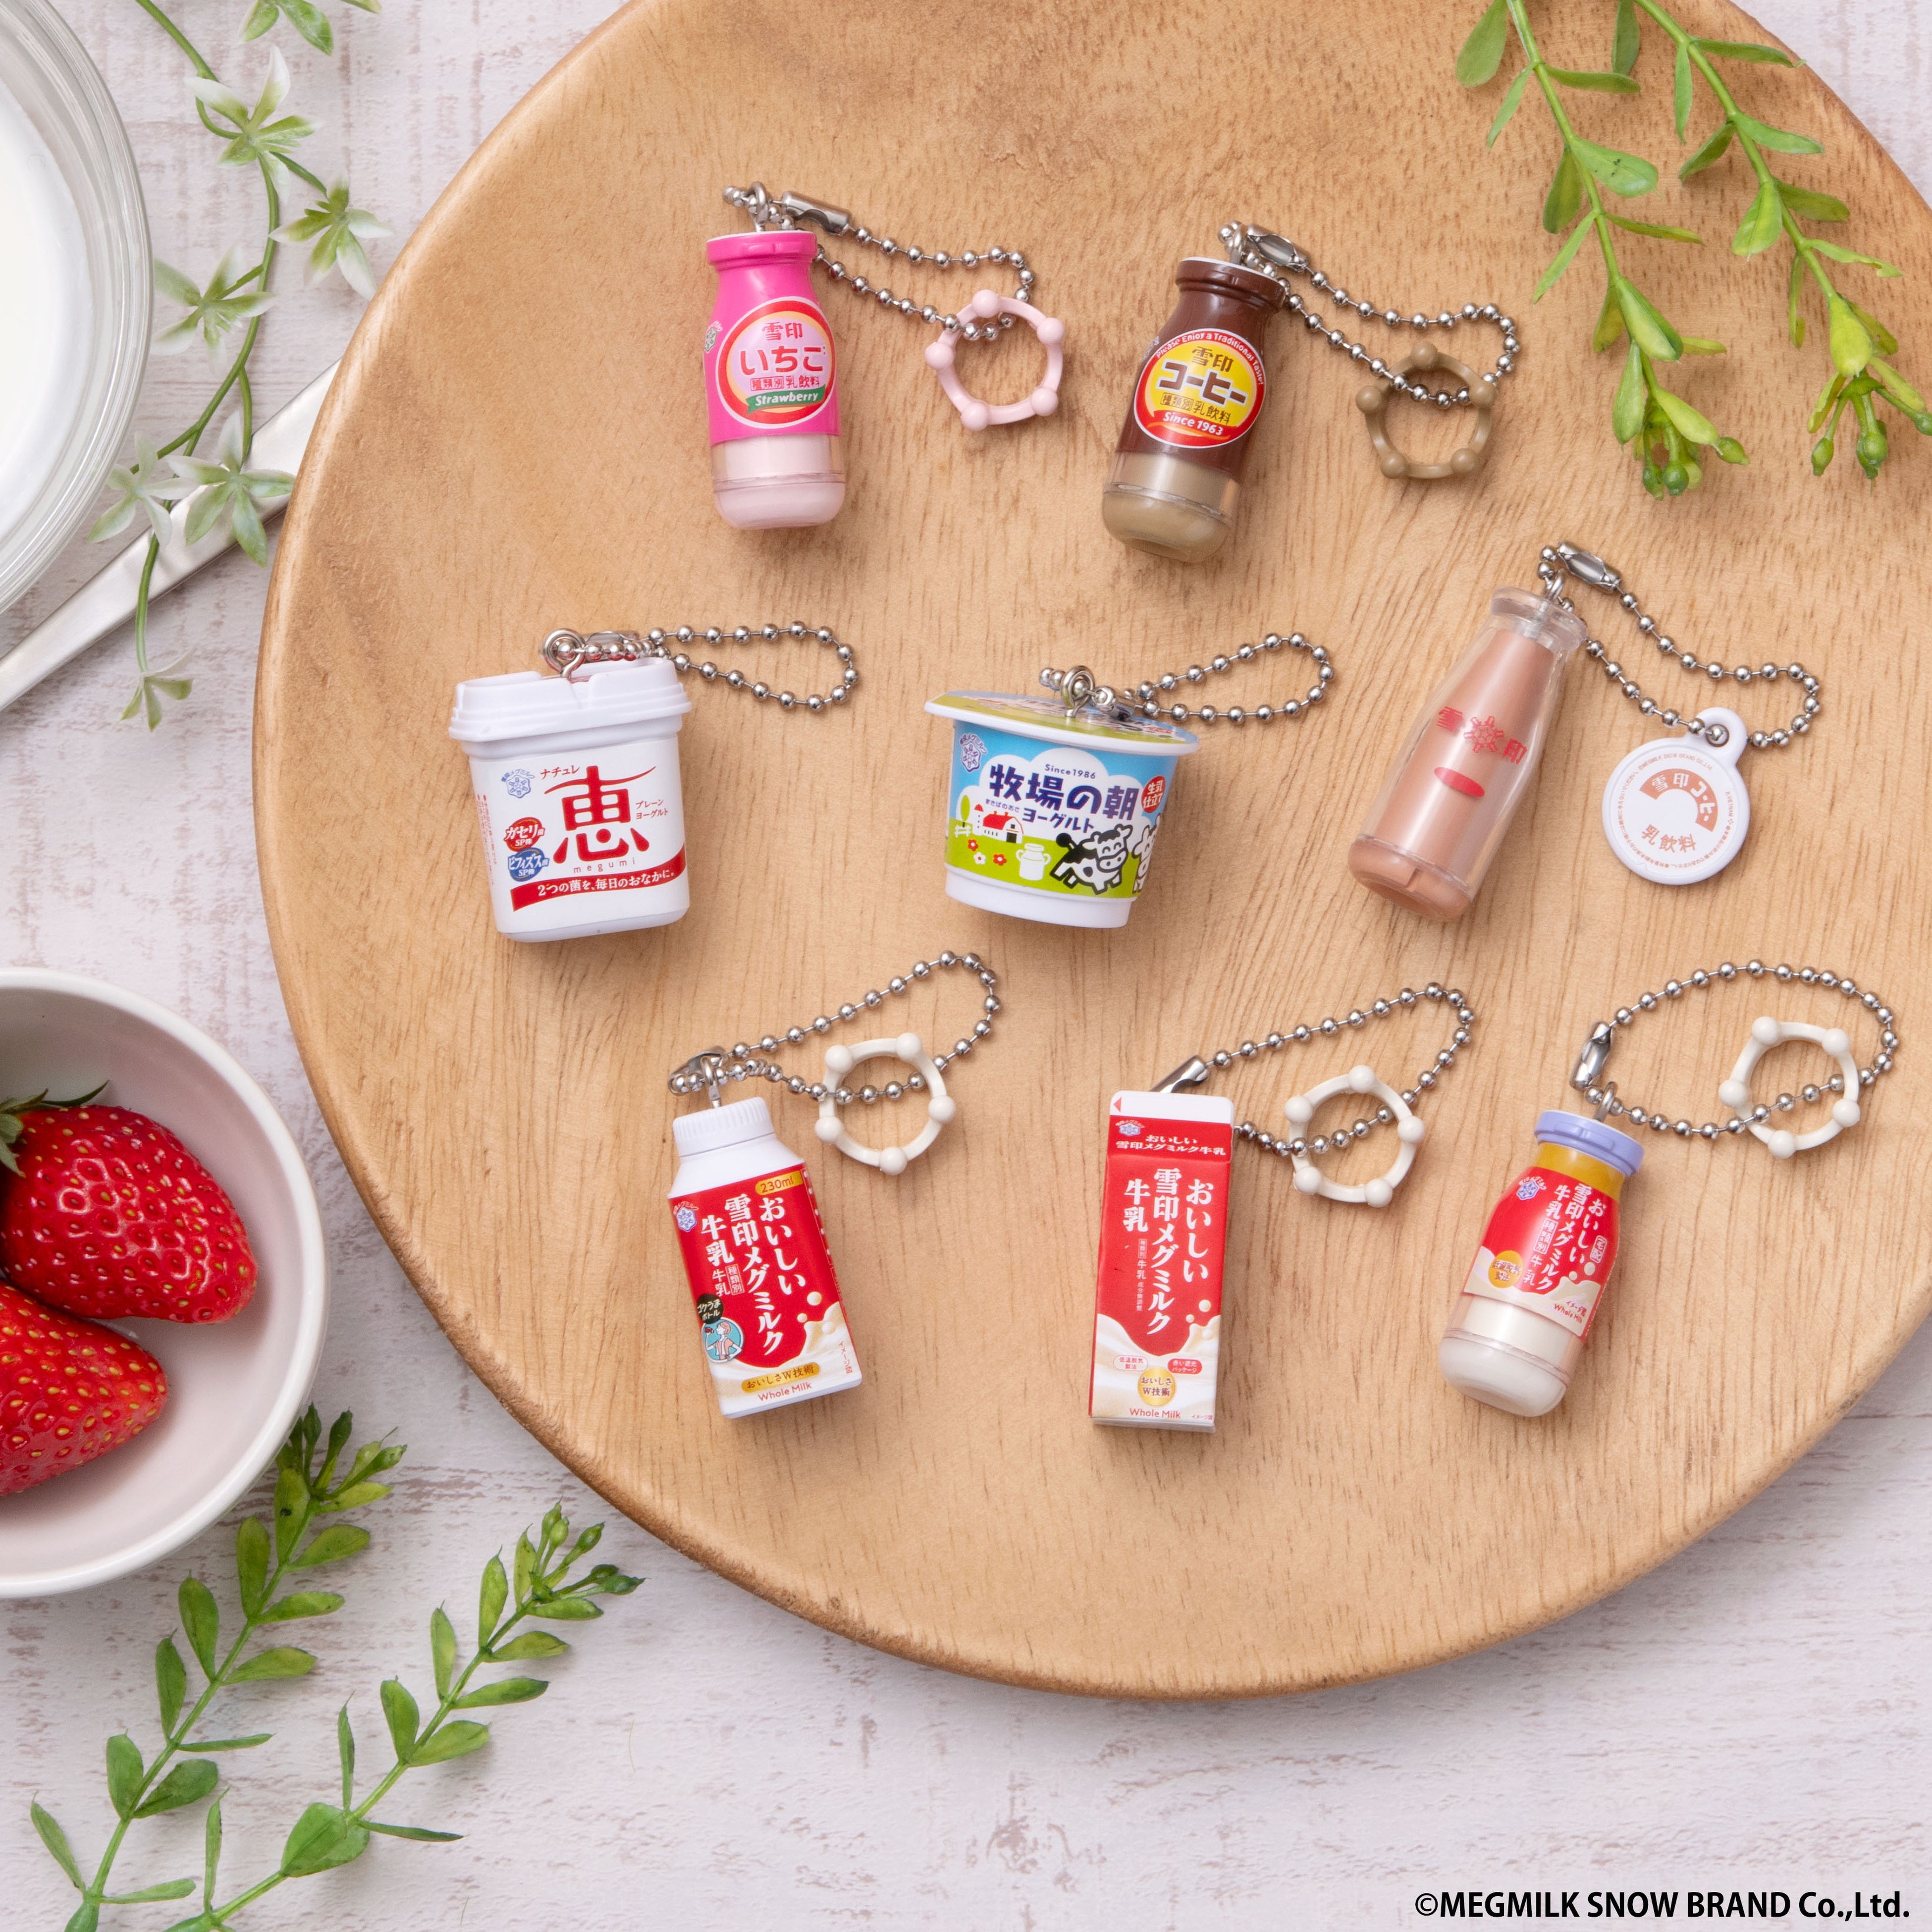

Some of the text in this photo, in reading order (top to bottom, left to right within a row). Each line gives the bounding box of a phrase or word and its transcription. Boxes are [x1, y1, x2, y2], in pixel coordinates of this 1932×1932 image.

[762, 322, 803, 340] 雪印
[740, 346, 826, 375] いちご
[1182, 333, 1204, 343] Enjoy
[1214, 333, 1255, 362] Traditional
[1191, 346, 1234, 372] 雪印
[1159, 361, 1246, 405] コーヒー
[755, 392, 818, 406] Strawberry
[1163, 412, 1224, 436] Since 1963
[540, 765, 580, 780] ナチュレ
[989, 763, 1139, 820] 牧場の朝
[1147, 779, 1164, 795] 生乳
[544, 765, 657, 864] 恵
[636, 808, 668, 819] ヨーグルト
[985, 798, 1020, 813] まきばのあさ
[1022, 807, 1094, 833] ヨーグルト
[1642, 824, 1697, 853] 乳飲料
[573, 858, 636, 873] megumi
[537, 869, 674, 896] 2つの菌を、毎日のおなかに。
[1115, 1140, 1226, 1156] 雪印メグミルク牛乳
[1145, 1134, 1197, 1144] おいしい
[759, 1176, 794, 1194] 230ml
[1123, 1178, 1151, 1233] 牛乳
[1545, 1184, 1571, 1220] 牛乳
[700, 1214, 735, 1267] 牛乳
[1182, 1179, 1215, 1283] おいしい
[1536, 1182, 1593, 1290] 雪印メグミルク
[1569, 1198, 1607, 1264] おいしい
[759, 1197, 806, 1295] おいしい
[1147, 1167, 1181, 1336] 雪印メグミルク
[712, 1269, 731, 1297] 牛乳
[725, 1193, 784, 1356] 雪印メグミルク
[747, 1365, 814, 1389] おいしさW技術
[1141, 1377, 1172, 1386] おいしさ
[757, 1382, 812, 1401] Whole Milk
[1142, 1387, 1171, 1397] W技術
[1129, 1408, 1181, 1419] Whole Milk
